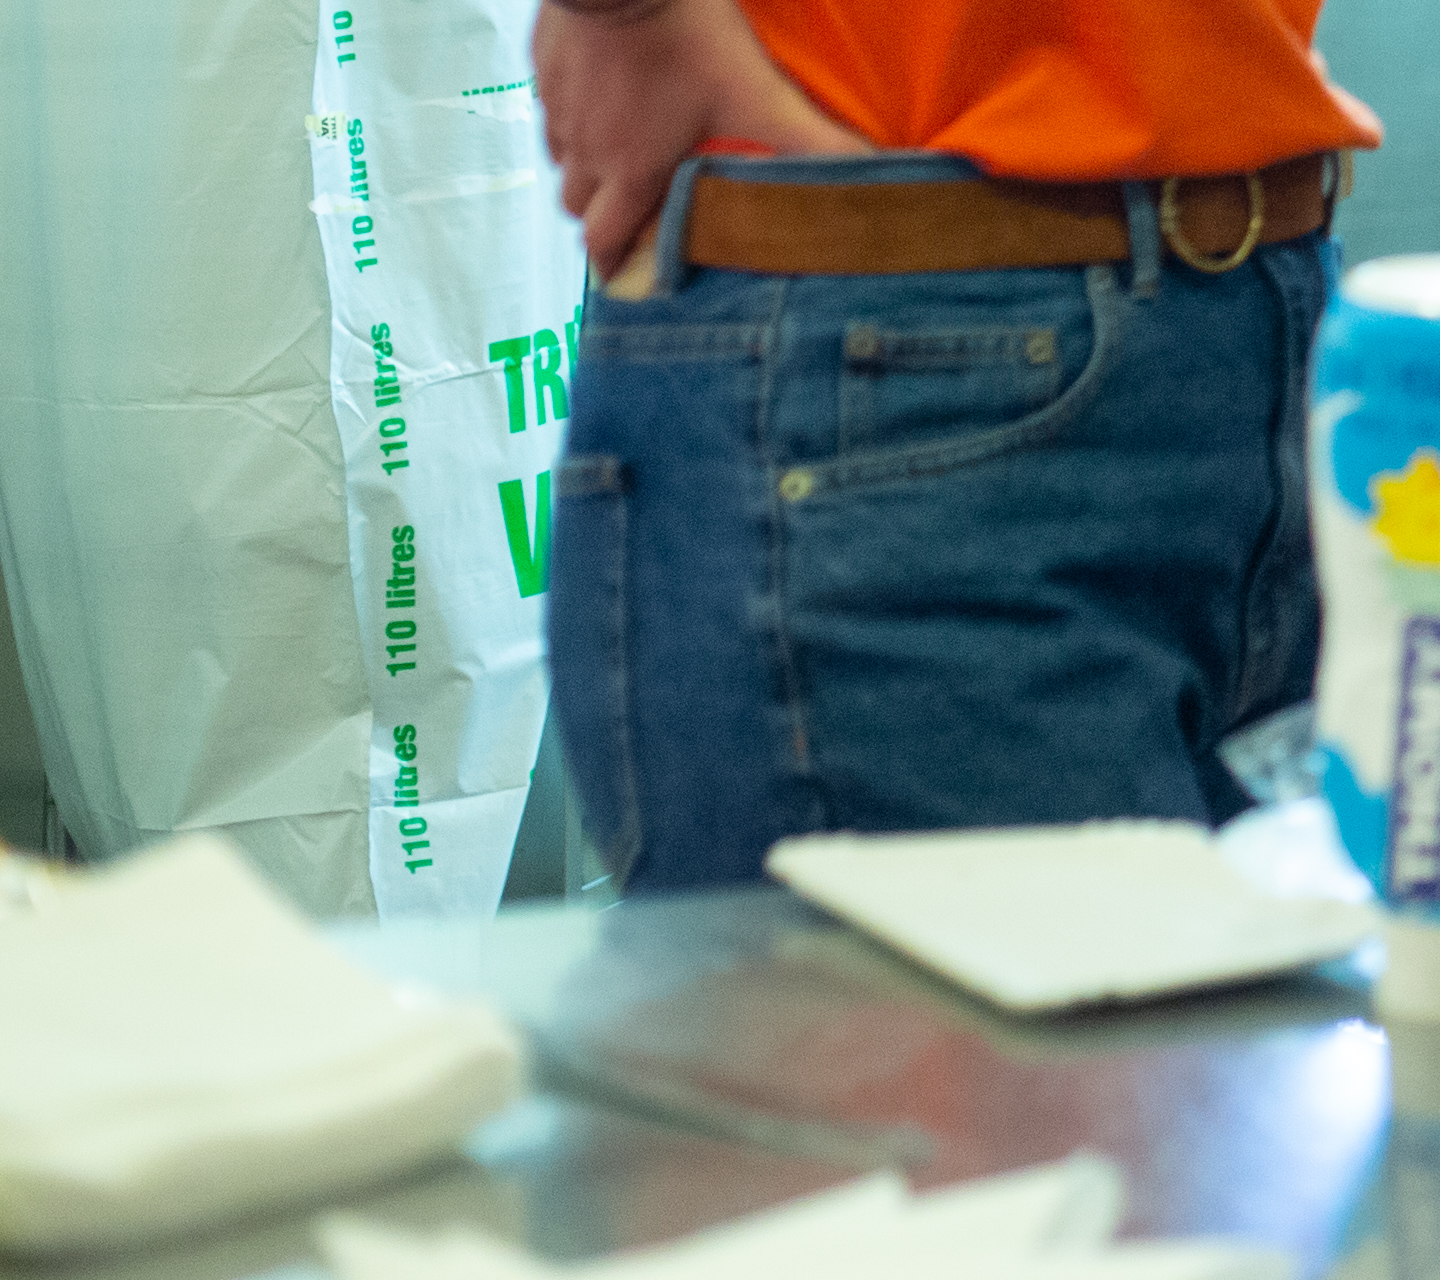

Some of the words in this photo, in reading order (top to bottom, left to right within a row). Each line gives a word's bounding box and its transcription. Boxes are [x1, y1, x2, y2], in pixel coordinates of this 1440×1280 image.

[333, 10, 357, 68] 110
[352, 214, 379, 273] 110
[370, 322, 402, 409] litres
[378, 416, 410, 476] 110
[385, 524, 417, 610] litres
[385, 619, 418, 678] 110
[393, 723, 420, 808] litres
[399, 816, 434, 875] 110
